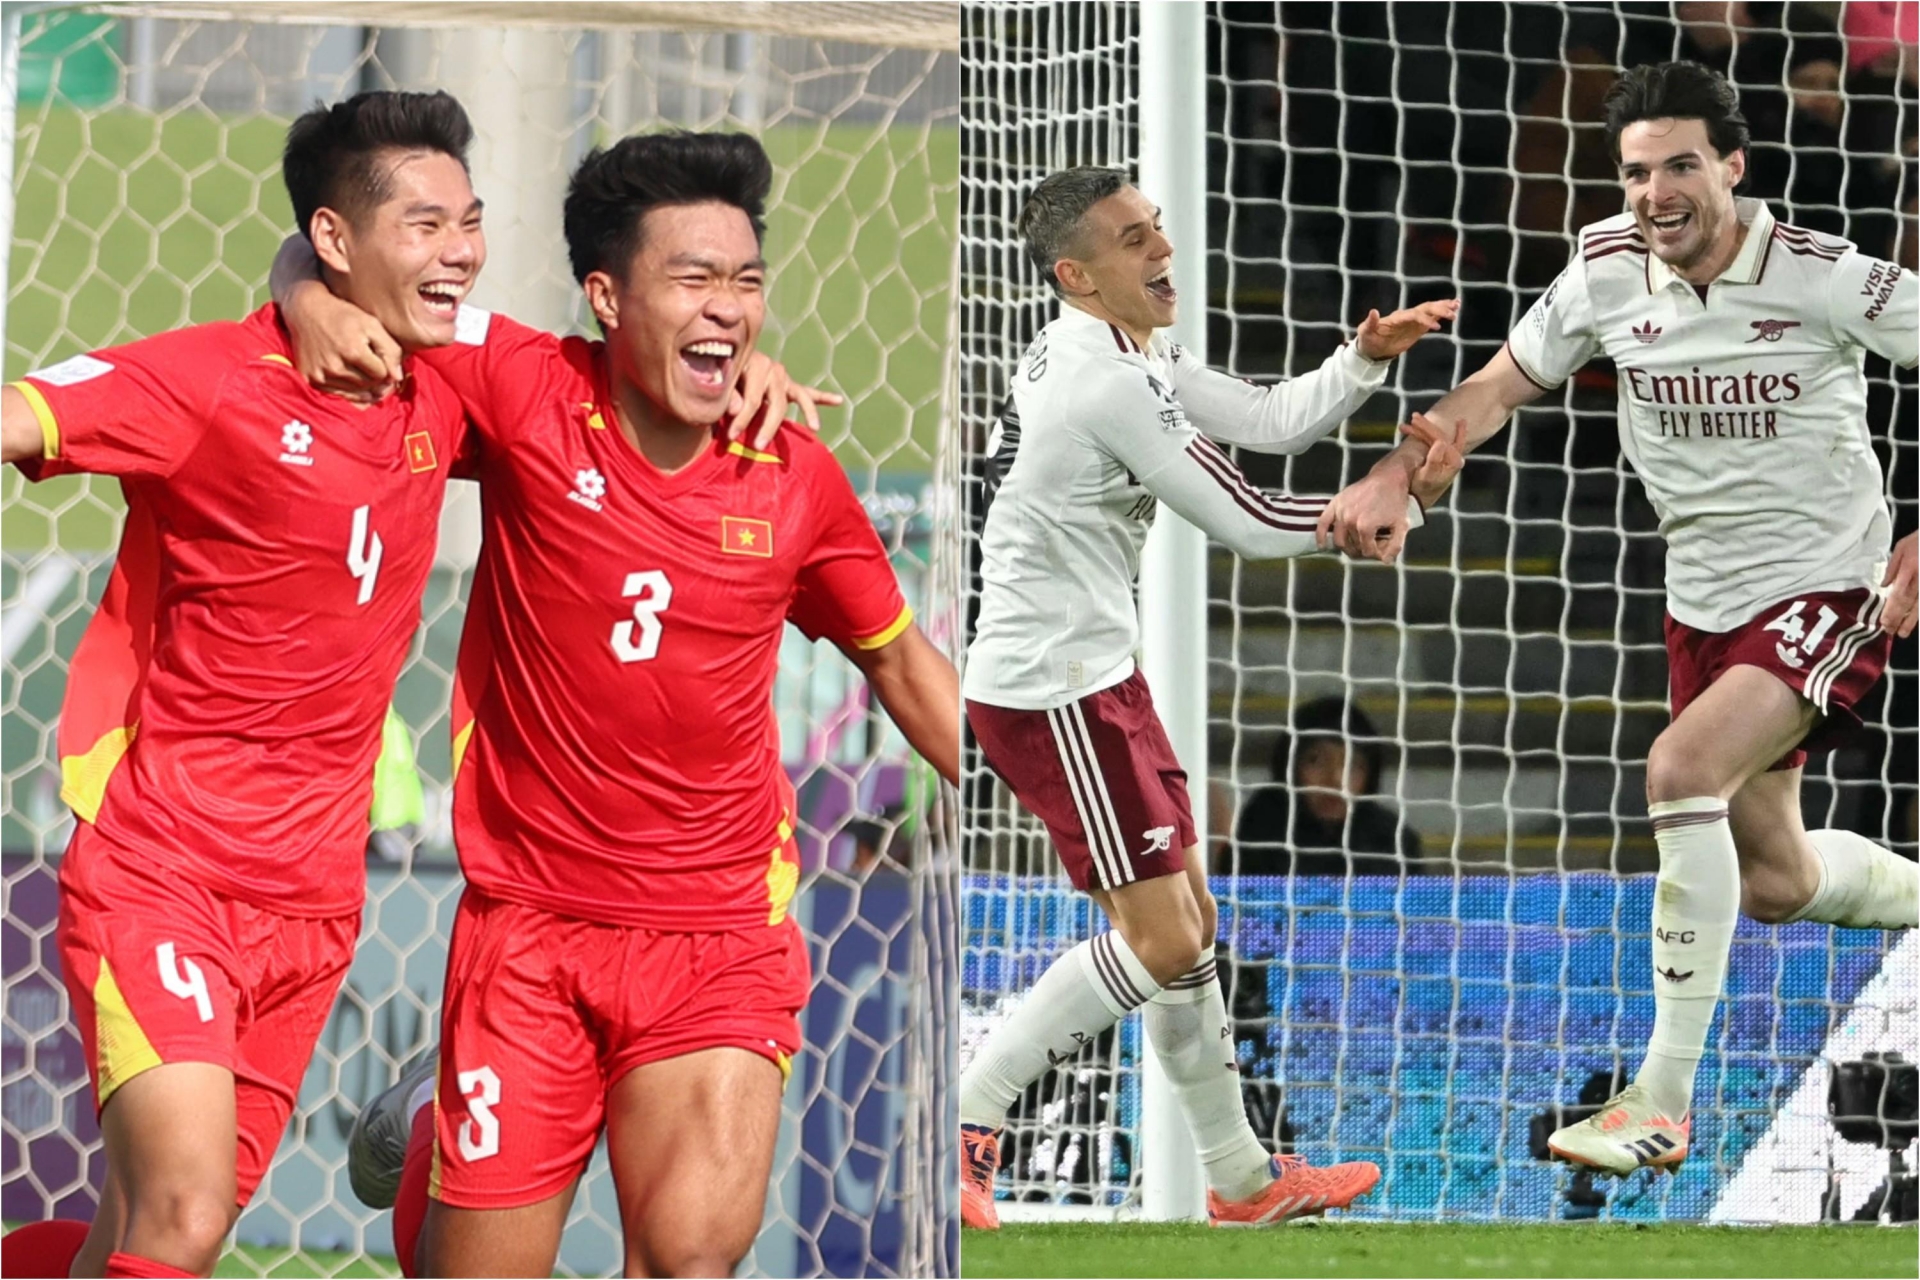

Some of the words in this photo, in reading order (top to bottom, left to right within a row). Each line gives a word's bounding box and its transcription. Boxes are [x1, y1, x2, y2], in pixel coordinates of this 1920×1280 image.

[1860, 261, 1886, 296] VISIT
[1626, 366, 1801, 405] Emirates
[1659, 410, 1690, 438] FLY
[1700, 411, 1778, 439] BETTER
[346, 505, 383, 606] 4
[610, 569, 673, 663] 3
[1762, 600, 1839, 656] 41
[1656, 927, 1695, 944] AFC
[155, 941, 215, 1023] 4
[457, 1065, 501, 1162] 3
